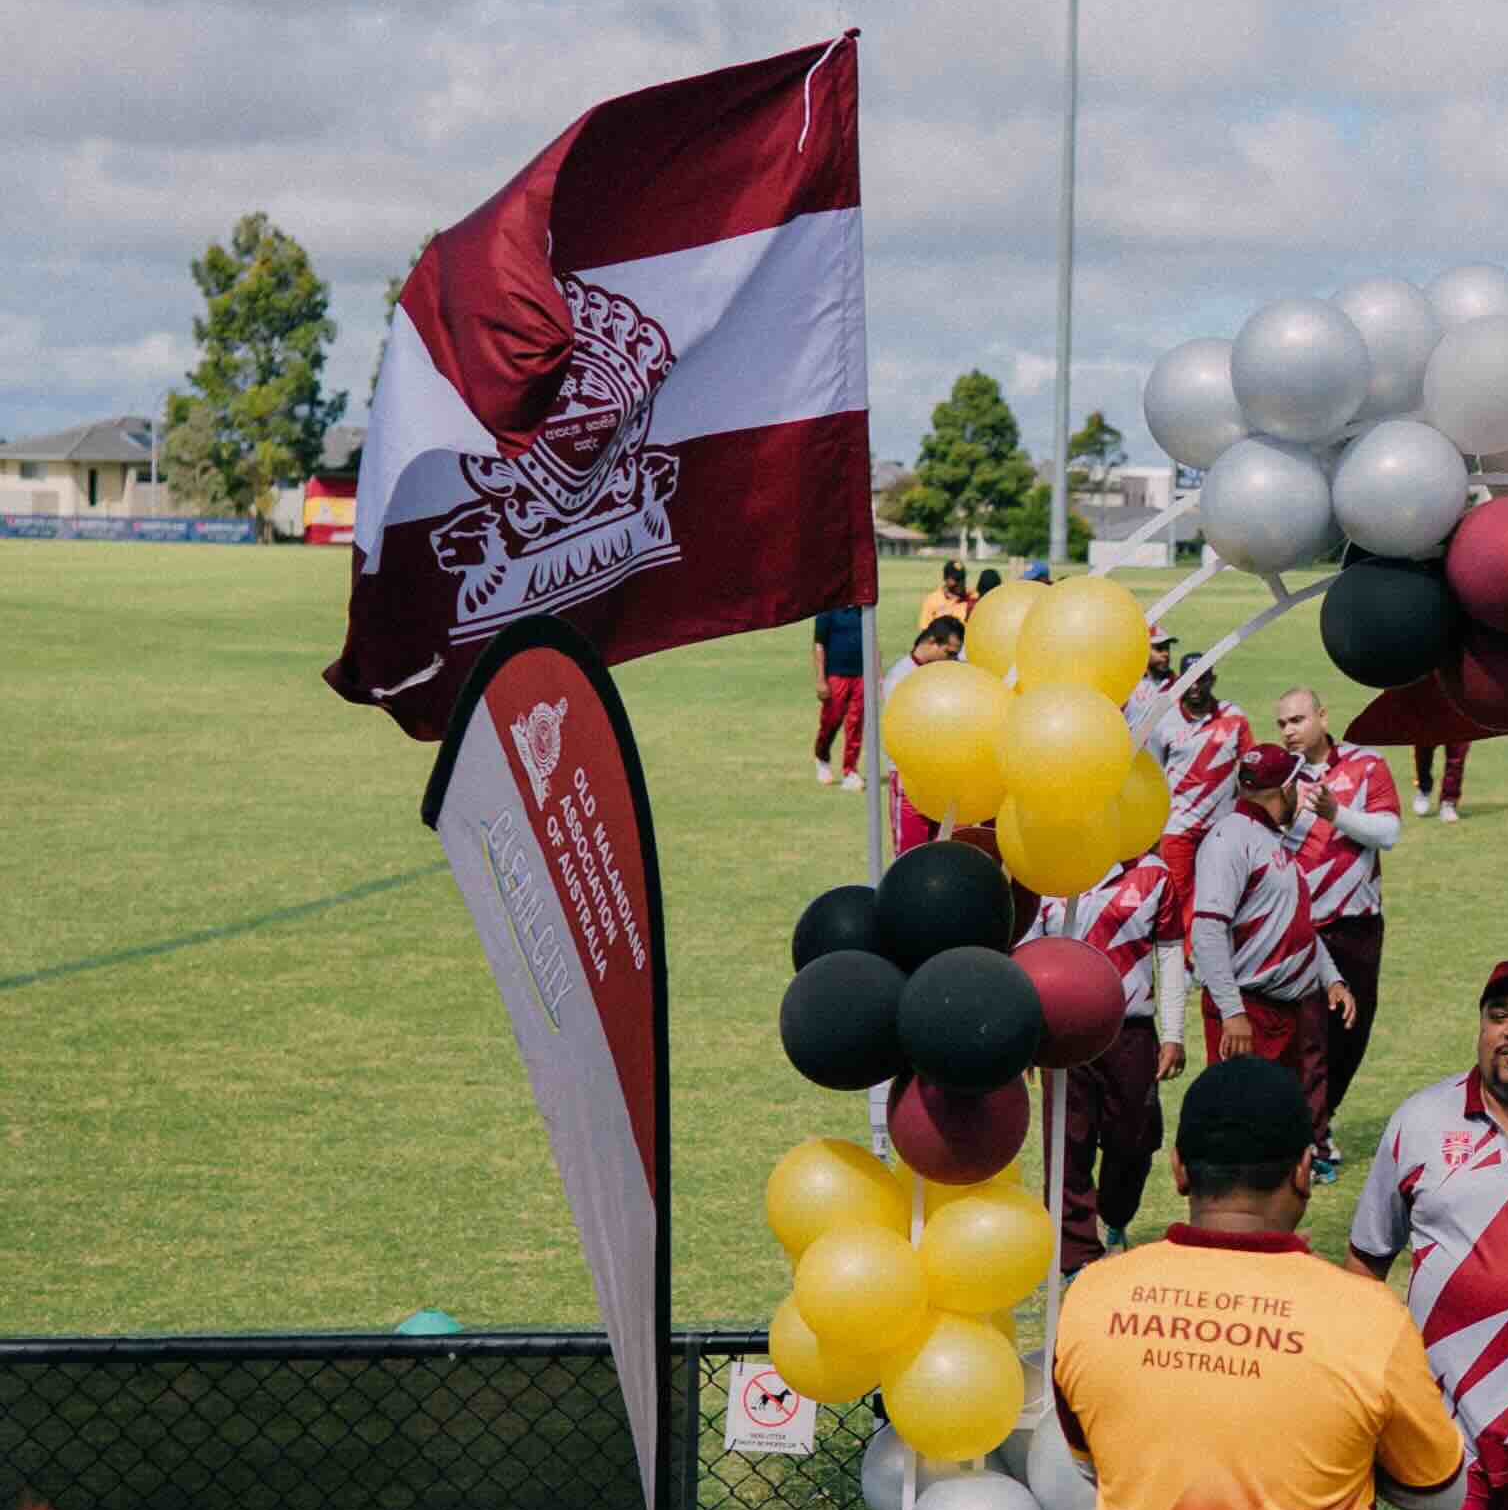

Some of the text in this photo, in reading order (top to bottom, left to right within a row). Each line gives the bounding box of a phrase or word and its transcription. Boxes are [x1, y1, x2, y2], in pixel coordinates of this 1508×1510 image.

[488, 810, 573, 1012] CLEAN CITY
[547, 816, 608, 981] OF AUSTRALIA
[560, 795, 618, 945] ASSOCIATION
[574, 767, 645, 970] OLD NALANDIANS
[1108, 1312, 1305, 1355] MAROONS
[1131, 1285, 1294, 1319] BATTLE OF THE
[1142, 1348, 1262, 1379] AUSTRALIA
